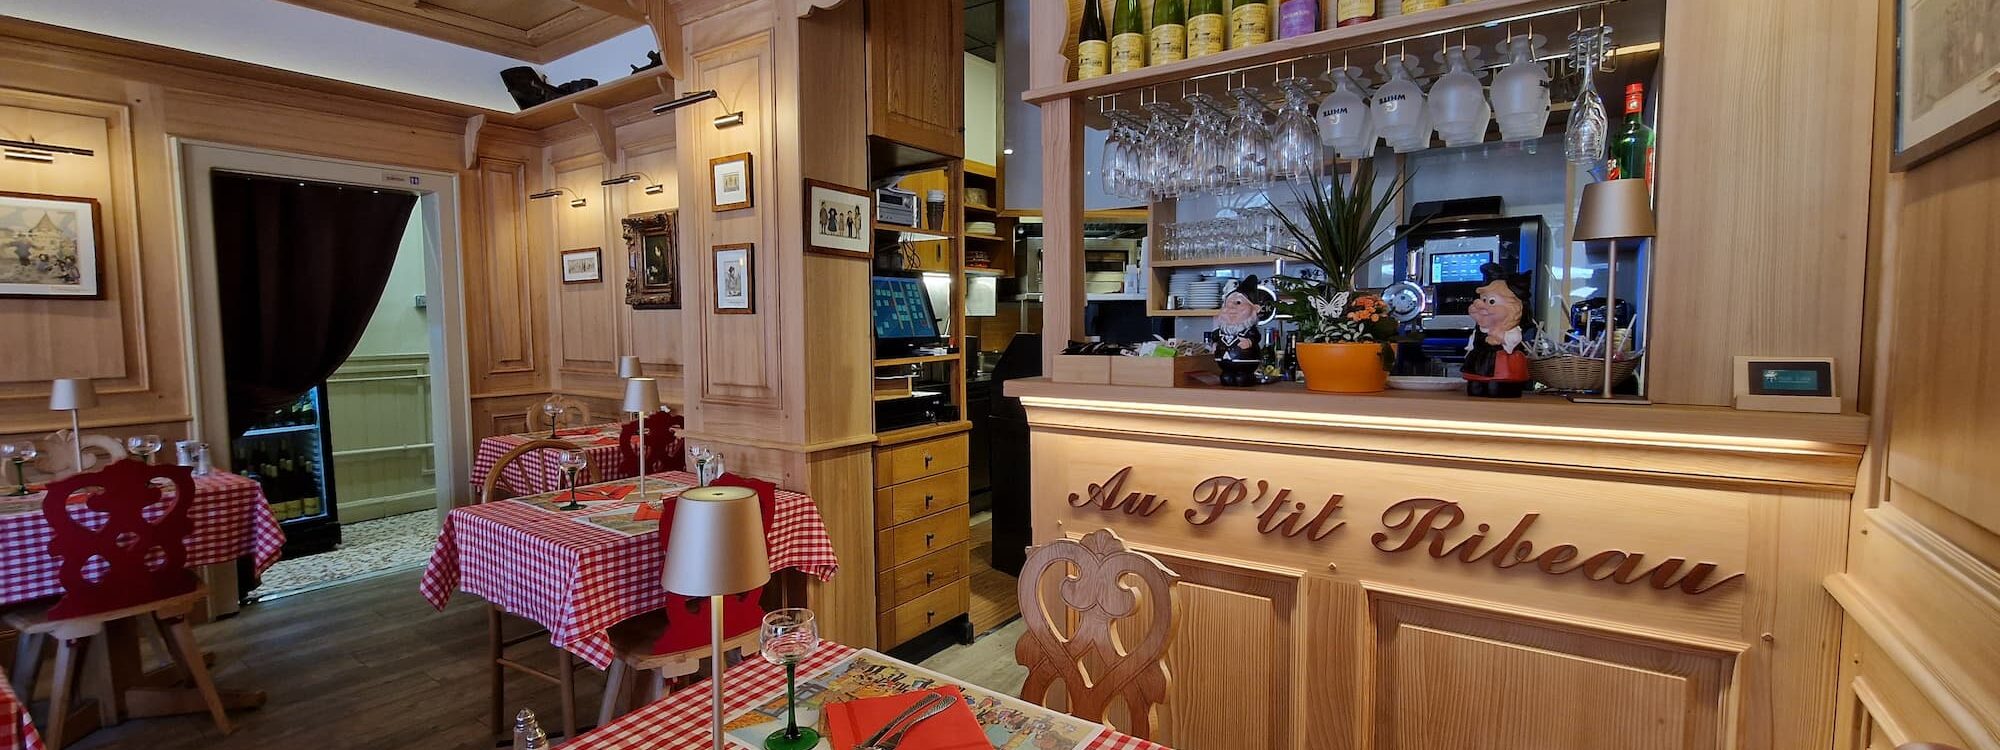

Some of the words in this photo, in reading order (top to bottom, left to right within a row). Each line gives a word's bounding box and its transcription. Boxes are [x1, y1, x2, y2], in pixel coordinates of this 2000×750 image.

[1379, 94, 1406, 105] WHITE
[1323, 107, 1348, 117] WHITE
[1068, 466, 1168, 517] Au
[1184, 475, 1346, 541] P'tit
[1371, 498, 1744, 595] Ribeau
